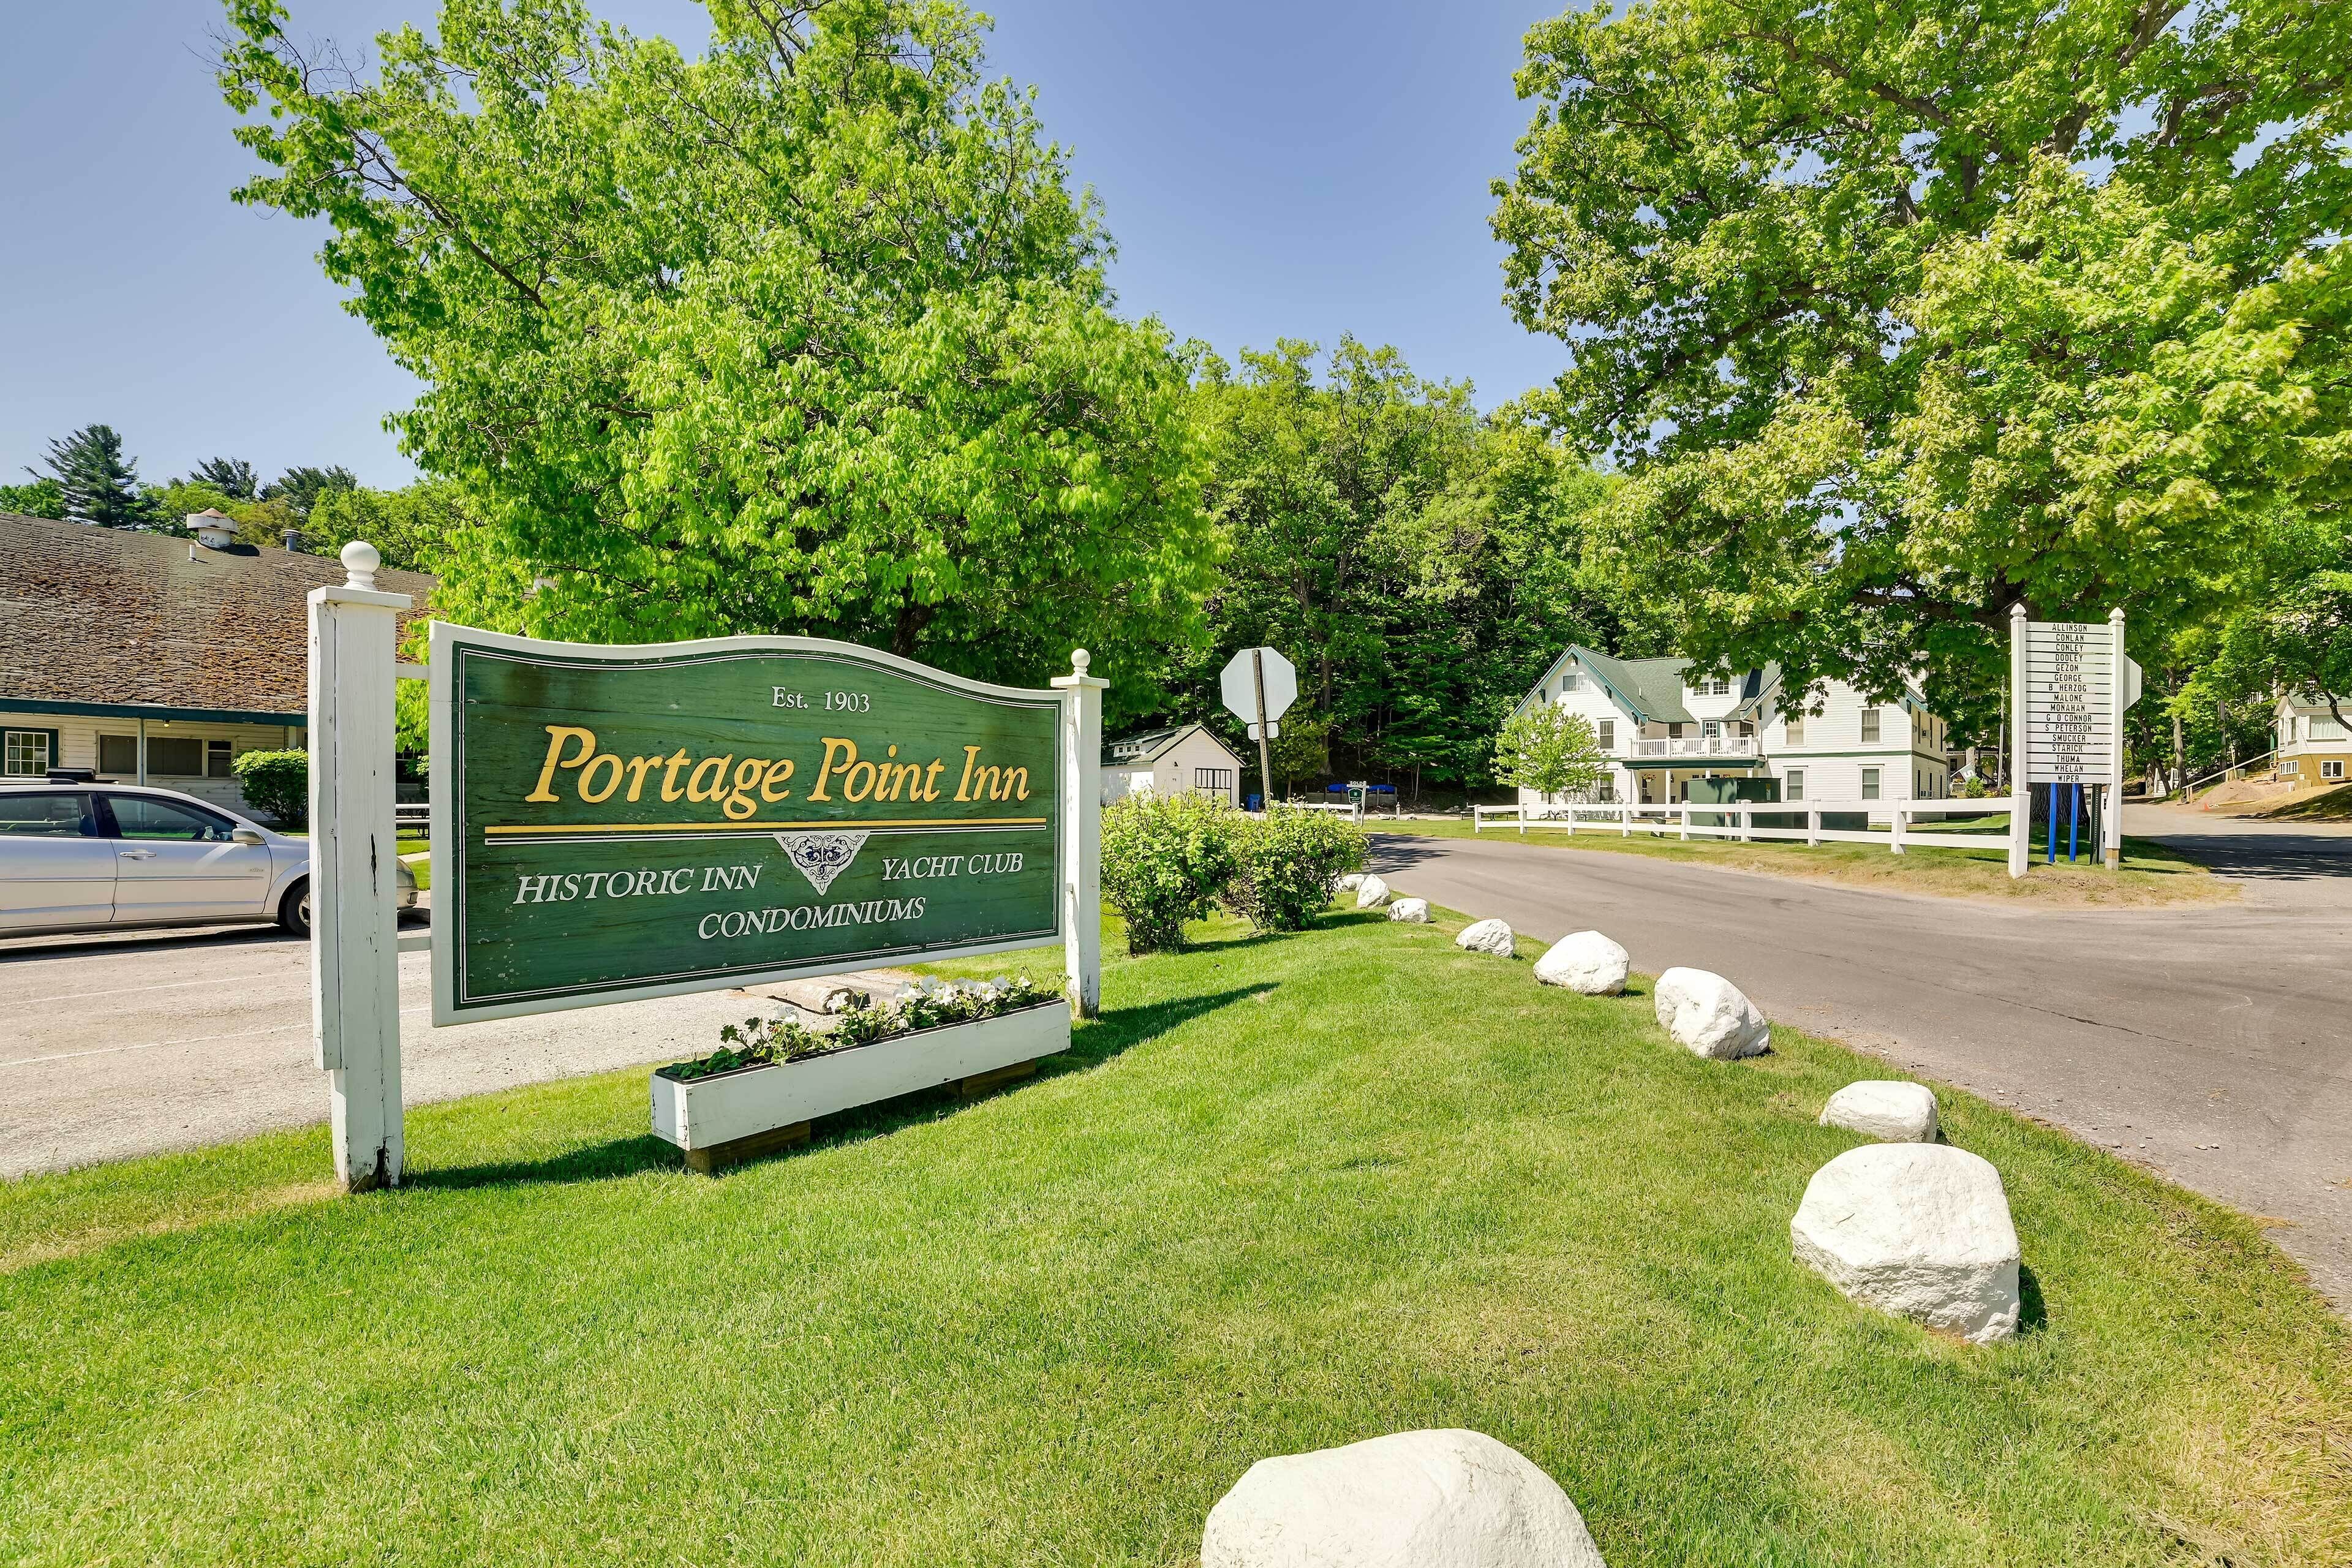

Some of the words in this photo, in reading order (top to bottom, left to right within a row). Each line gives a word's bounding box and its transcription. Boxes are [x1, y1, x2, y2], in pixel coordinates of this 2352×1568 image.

[2052, 624, 2087, 632] ALLINSON
[2056, 633, 2084, 642] CONLAN
[2056, 643, 2083, 652] CONLEY
[2055, 654, 2083, 662] DOOLEY
[2056, 663, 2079, 672] GEZON
[2054, 674, 2082, 682] GEORGE
[2059, 684, 2087, 692] HERZOG
[771, 685, 809, 709] Est.
[824, 690, 870, 713] 1903
[2050, 704, 2085, 712] MONAHAN
[2057, 714, 2092, 722] O'CONNOR
[2055, 724, 2092, 733] PETERSON
[2052, 734, 2086, 742] SMUCKER
[2052, 744, 2083, 752] STARICK
[525, 725, 795, 821] Portage
[807, 736, 946, 802] Point
[953, 745, 1030, 802] Inn
[882, 855, 965, 881] YACHT
[968, 852, 1024, 875] CLUB
[512, 868, 695, 905] HISTORIC
[699, 864, 763, 892] INN
[698, 897, 927, 940] CONDOMINIUMS
